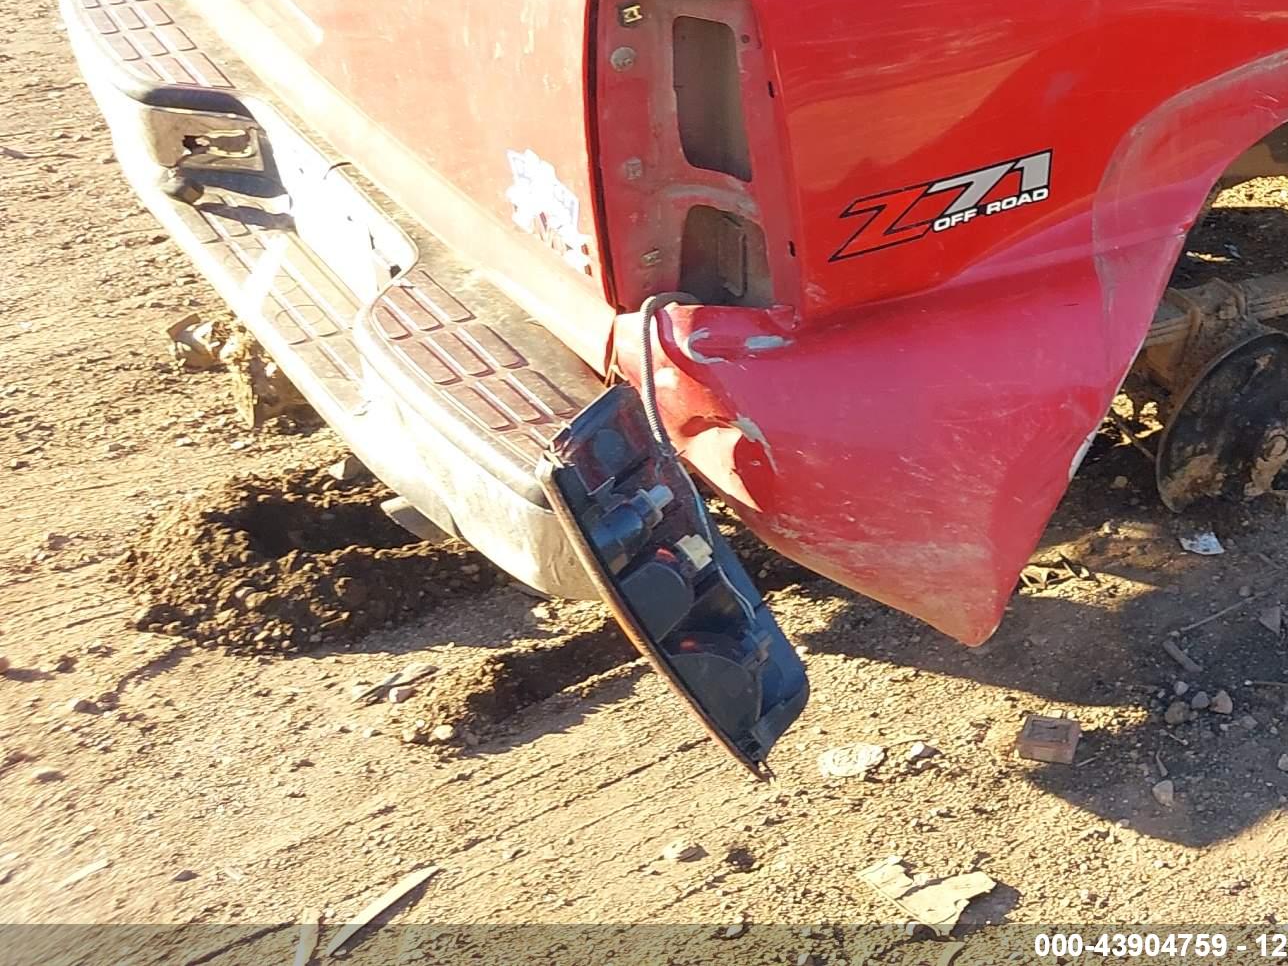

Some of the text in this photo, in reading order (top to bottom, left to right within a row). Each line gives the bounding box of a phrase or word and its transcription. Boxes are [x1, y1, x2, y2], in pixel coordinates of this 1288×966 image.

[827, 148, 1054, 264] Z71
[932, 186, 1050, 232] OFF ROAD
